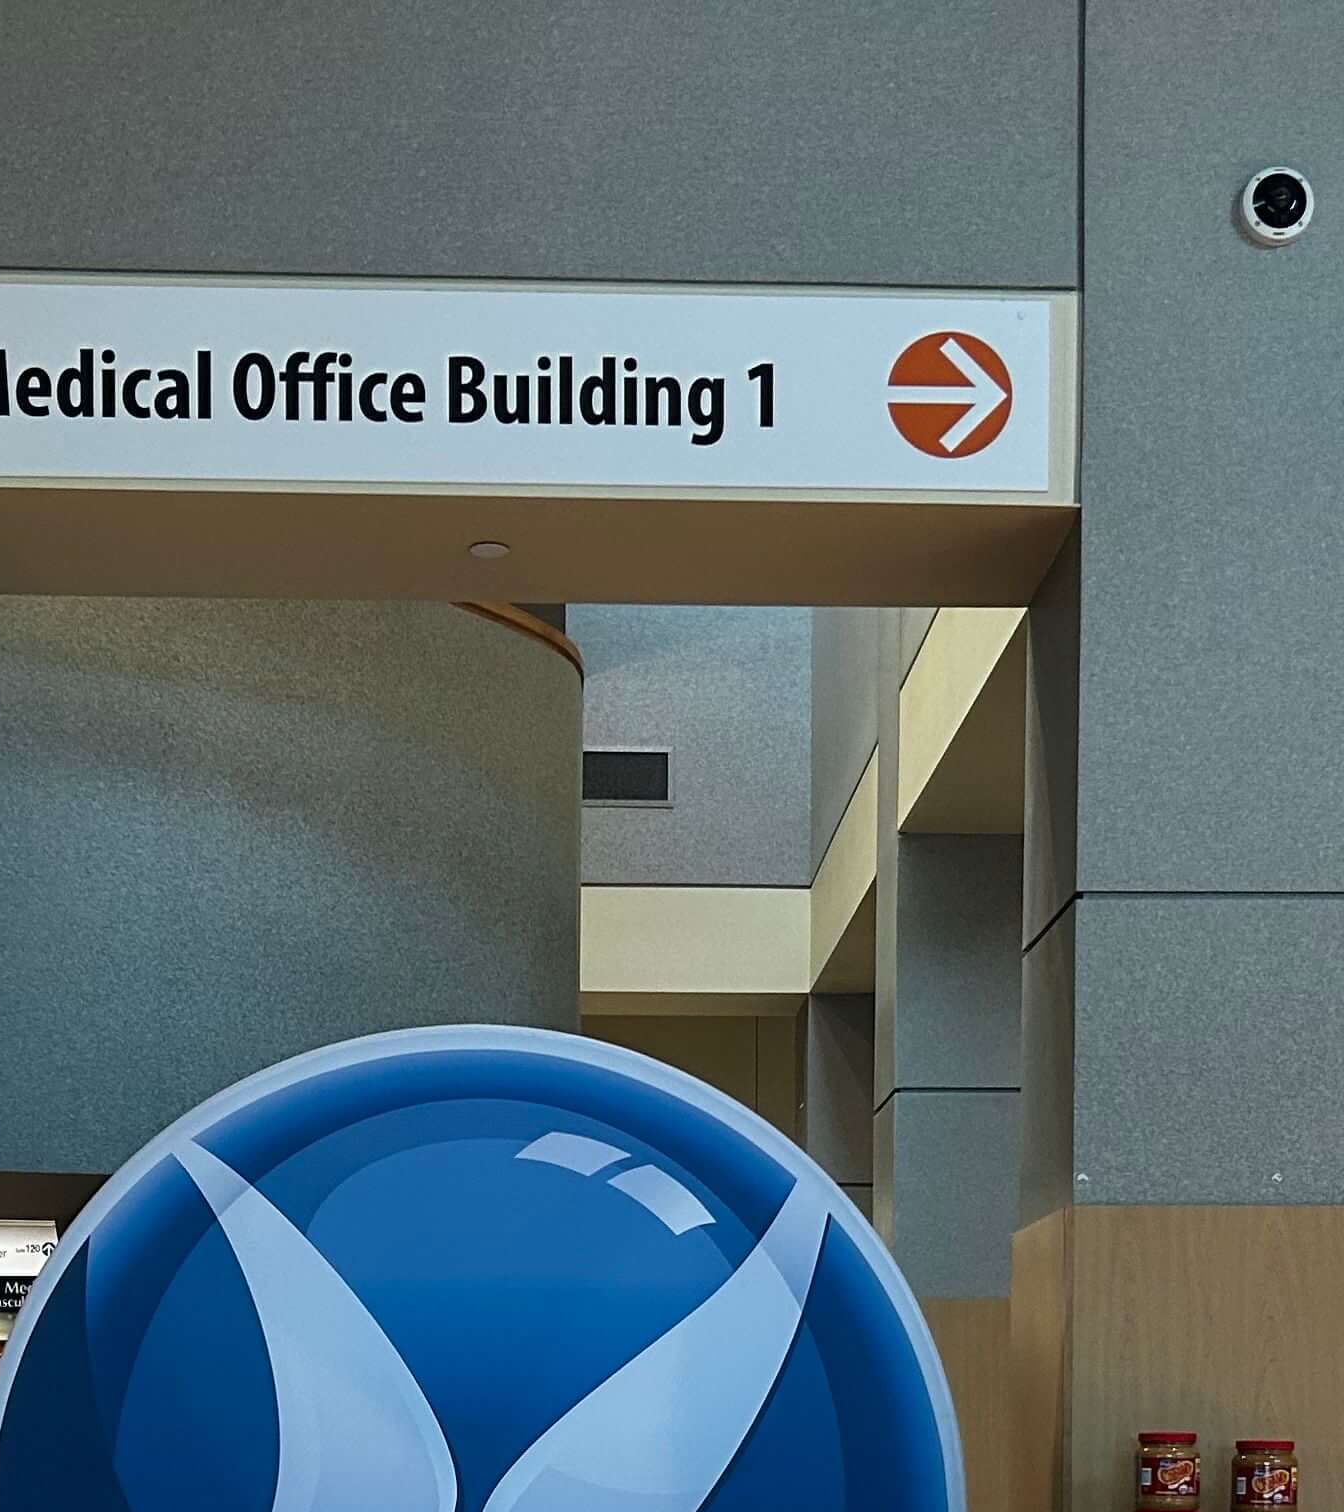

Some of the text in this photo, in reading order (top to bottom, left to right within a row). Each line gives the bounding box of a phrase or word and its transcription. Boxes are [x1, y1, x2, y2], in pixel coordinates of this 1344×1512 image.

[232, 350, 426, 424] Office
[447, 357, 726, 445] Building
[747, 362, 775, 427] 1
[26, 1245, 40, 1253] 120
